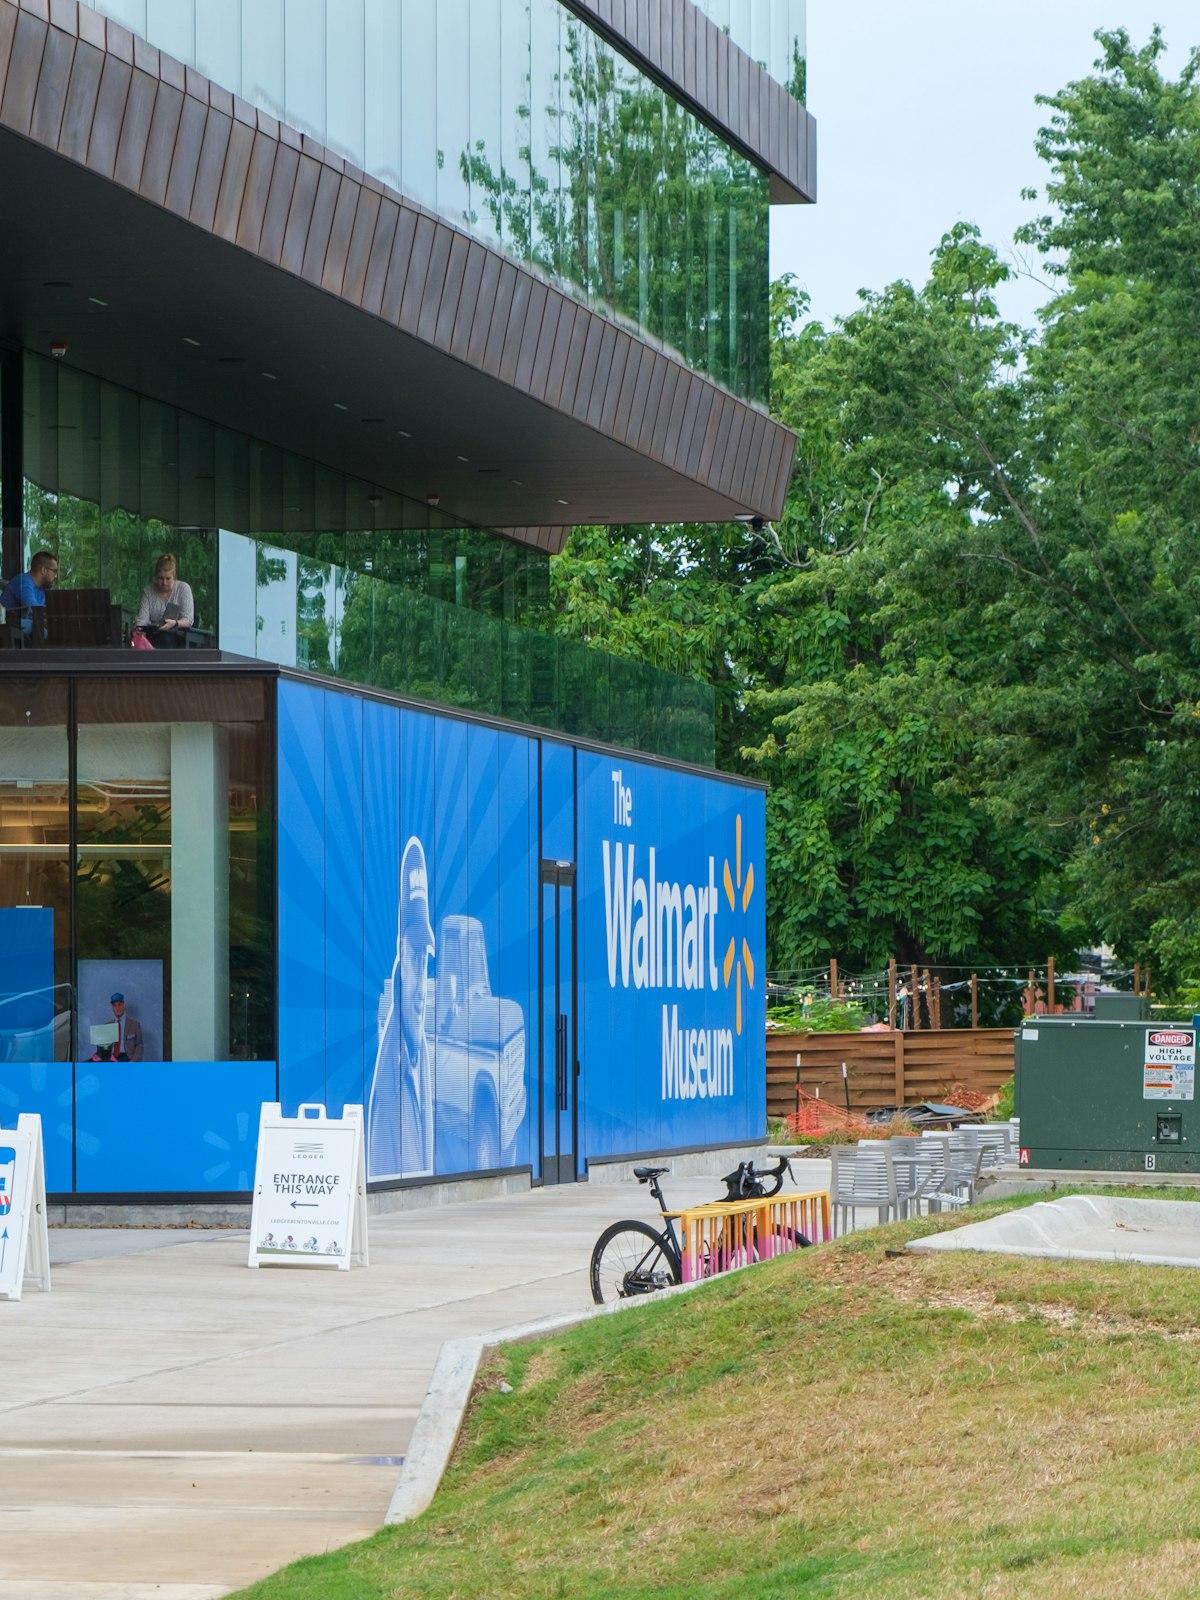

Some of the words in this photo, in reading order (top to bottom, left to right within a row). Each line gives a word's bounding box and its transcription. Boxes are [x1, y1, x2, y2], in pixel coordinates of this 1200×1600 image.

[612, 770, 632, 827] The
[602, 840, 718, 991] Walmart
[1155, 1035, 1187, 1044] DANGER
[661, 1004, 734, 1100] Museum
[1020, 1151, 1029, 1163] A
[1146, 1156, 1154, 1168] B
[273, 1173, 340, 1185] ENTRANCE
[275, 1184, 302, 1194] THIS
[305, 1184, 335, 1195] WAY
